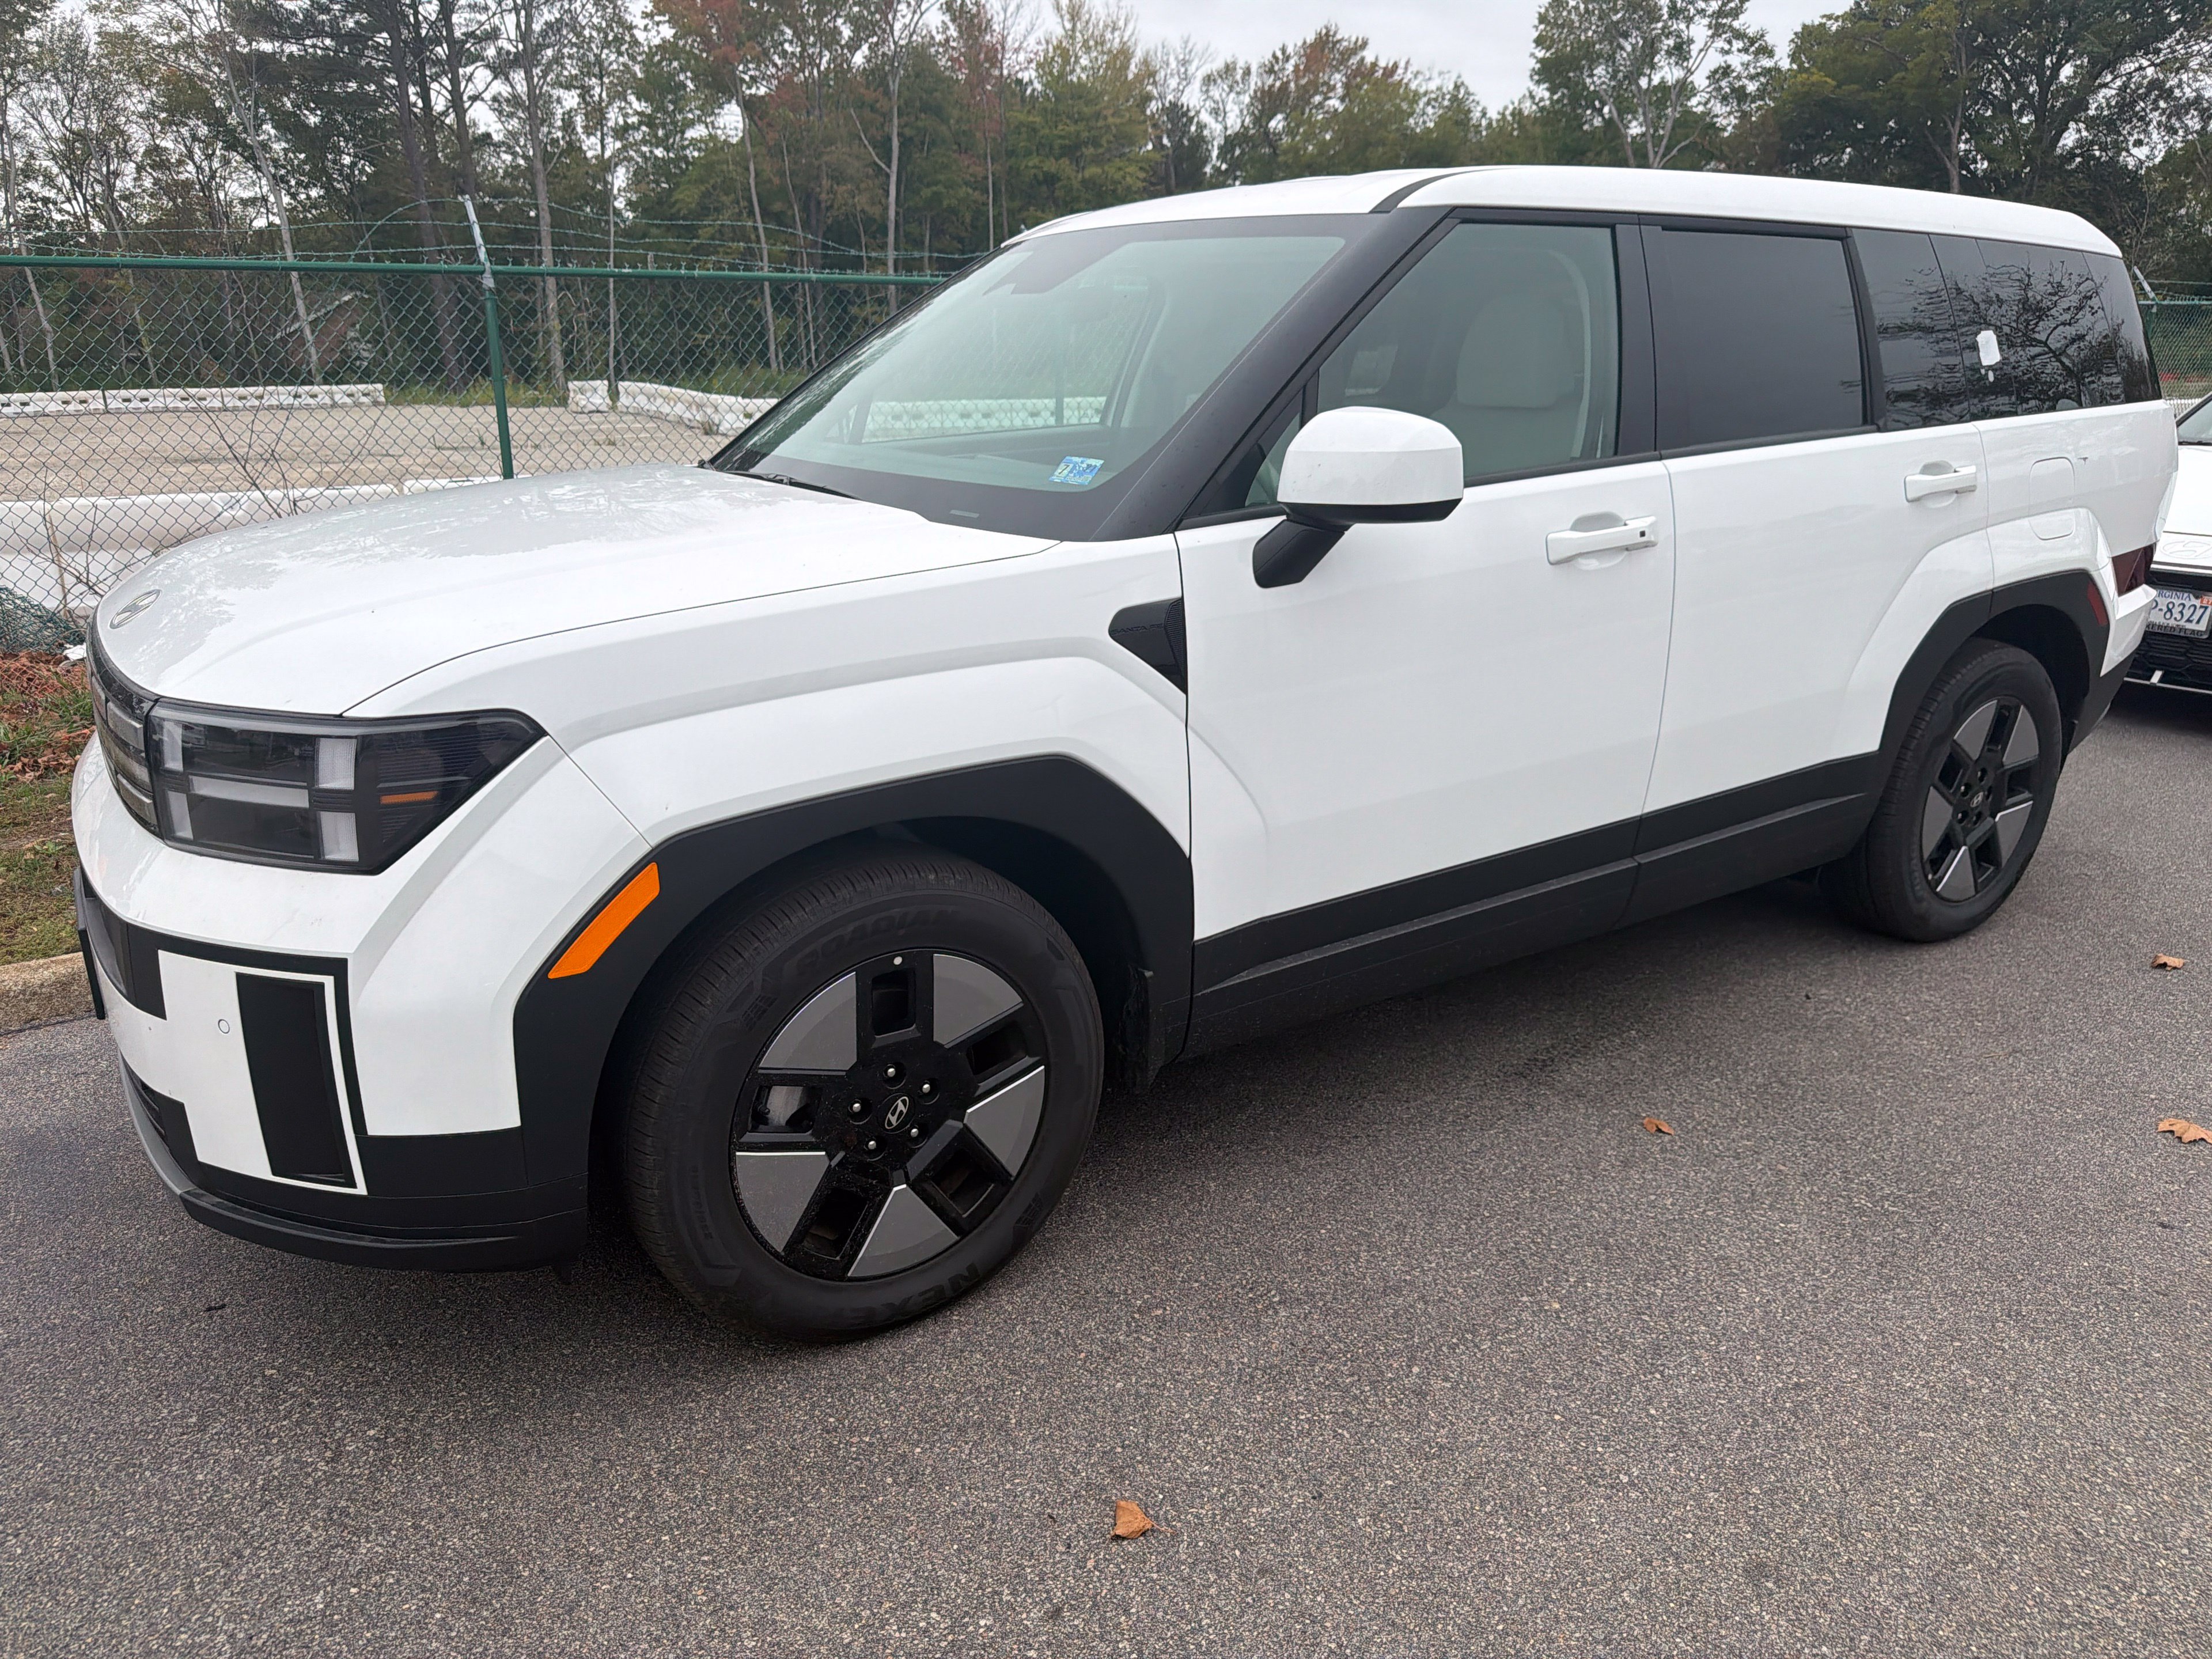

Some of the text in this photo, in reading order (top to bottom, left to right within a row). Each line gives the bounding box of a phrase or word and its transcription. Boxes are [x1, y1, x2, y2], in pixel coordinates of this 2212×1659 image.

[1059, 464, 1070, 475] 7
[2157, 589, 2191, 601] RGINIA
[1110, 626, 1148, 635] SANTA
[2145, 623, 2176, 632] KERED
[2179, 626, 2203, 637] FLAG
